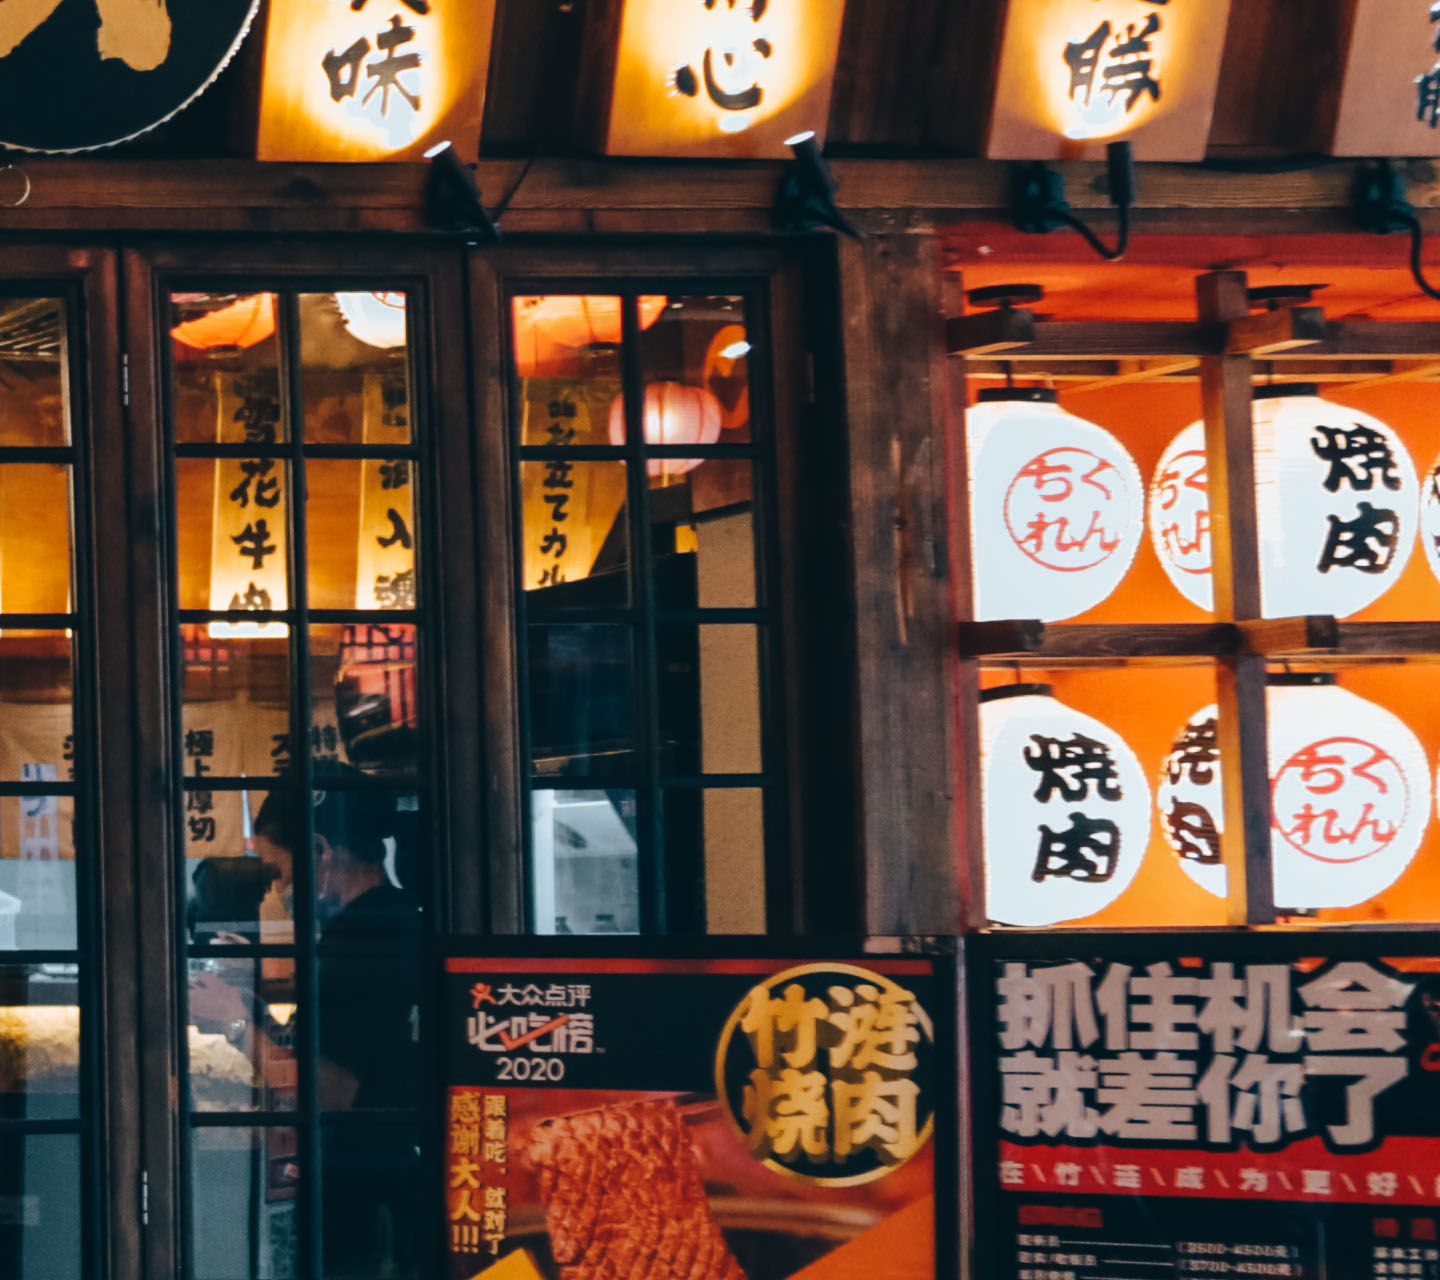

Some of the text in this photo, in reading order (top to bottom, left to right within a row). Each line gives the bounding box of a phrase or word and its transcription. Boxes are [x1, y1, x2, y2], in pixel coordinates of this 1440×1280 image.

[1310, 424, 1401, 573] 焼肉
[1023, 731, 1122, 883] 焼肉
[497, 984, 592, 1008] 大众点评
[997, 961, 1417, 1052] 抓住机会
[496, 1057, 565, 1082] 2020
[998, 1050, 1409, 1147] 就差你了
